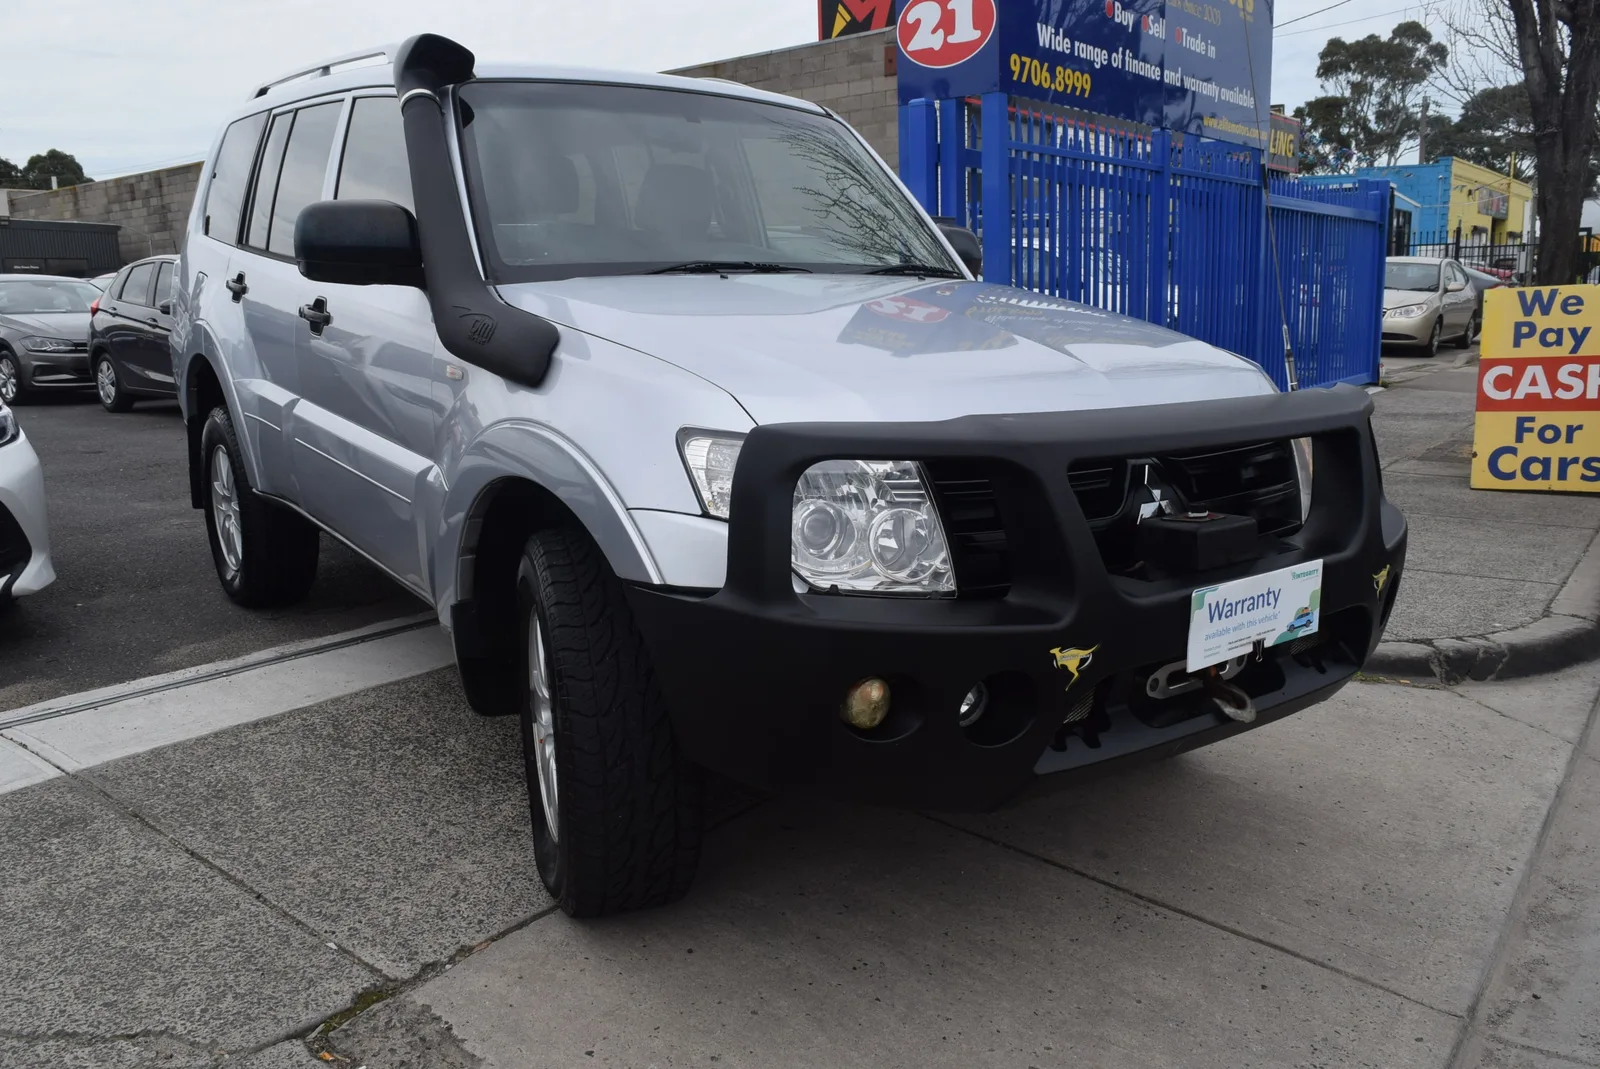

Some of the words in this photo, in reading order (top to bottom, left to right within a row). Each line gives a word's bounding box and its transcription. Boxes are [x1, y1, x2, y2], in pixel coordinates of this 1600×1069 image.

[906, 0, 981, 51] 21
[1114, 0, 1134, 33] Buy
[1148, 14, 1166, 40] Sell
[1181, 27, 1206, 55] Trade
[1207, 39, 1216, 59] in
[1009, 53, 1092, 98] 9706.8999
[1036, 22, 1071, 54] Wide
[1074, 40, 1109, 69] range
[1111, 46, 1123, 69] of
[1125, 49, 1161, 81] finance
[1163, 67, 1182, 87] and
[1183, 75, 1220, 102] warranty
[1220, 86, 1255, 109] available
[1517, 288, 1585, 317] We
[1512, 320, 1592, 355] Pay
[1514, 416, 1584, 444] For
[1487, 445, 1600, 482] Cars
[1208, 587, 1281, 624] Warranty
[1204, 626, 1232, 641] available
[1231, 620, 1246, 633] with
[1246, 617, 1258, 629] this
